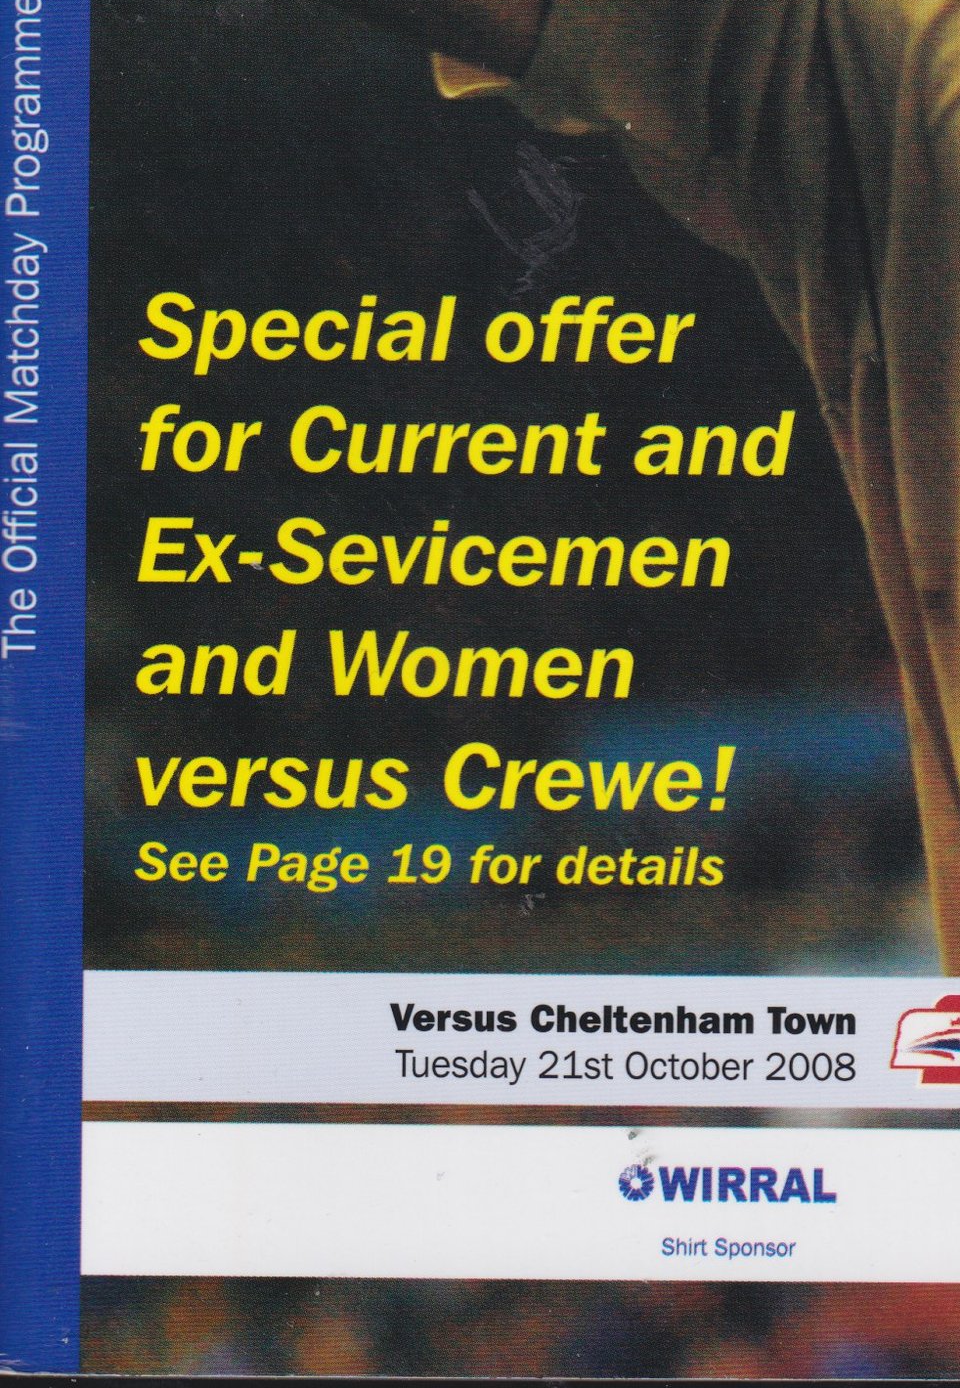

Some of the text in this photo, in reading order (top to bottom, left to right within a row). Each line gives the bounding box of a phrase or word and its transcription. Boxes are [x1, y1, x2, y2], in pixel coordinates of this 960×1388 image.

[3, 232, 48, 424] Matchday
[138, 292, 696, 375] Special offer
[139, 404, 796, 477] for Current and
[2, 442, 39, 574] Official
[137, 516, 732, 588] Ex-Sevicemen
[1, 586, 38, 659] The
[135, 629, 636, 699] and Women
[135, 742, 737, 812] versus Crewe!
[134, 841, 726, 894] See Page 19 for details
[390, 1003, 857, 1035] Versus Cheltenham Town
[395, 1049, 857, 1086] Tuesday 21st October 2008
[659, 1166, 837, 1203] WIRRAL
[661, 1237, 796, 1259] Shirt Sponsor
